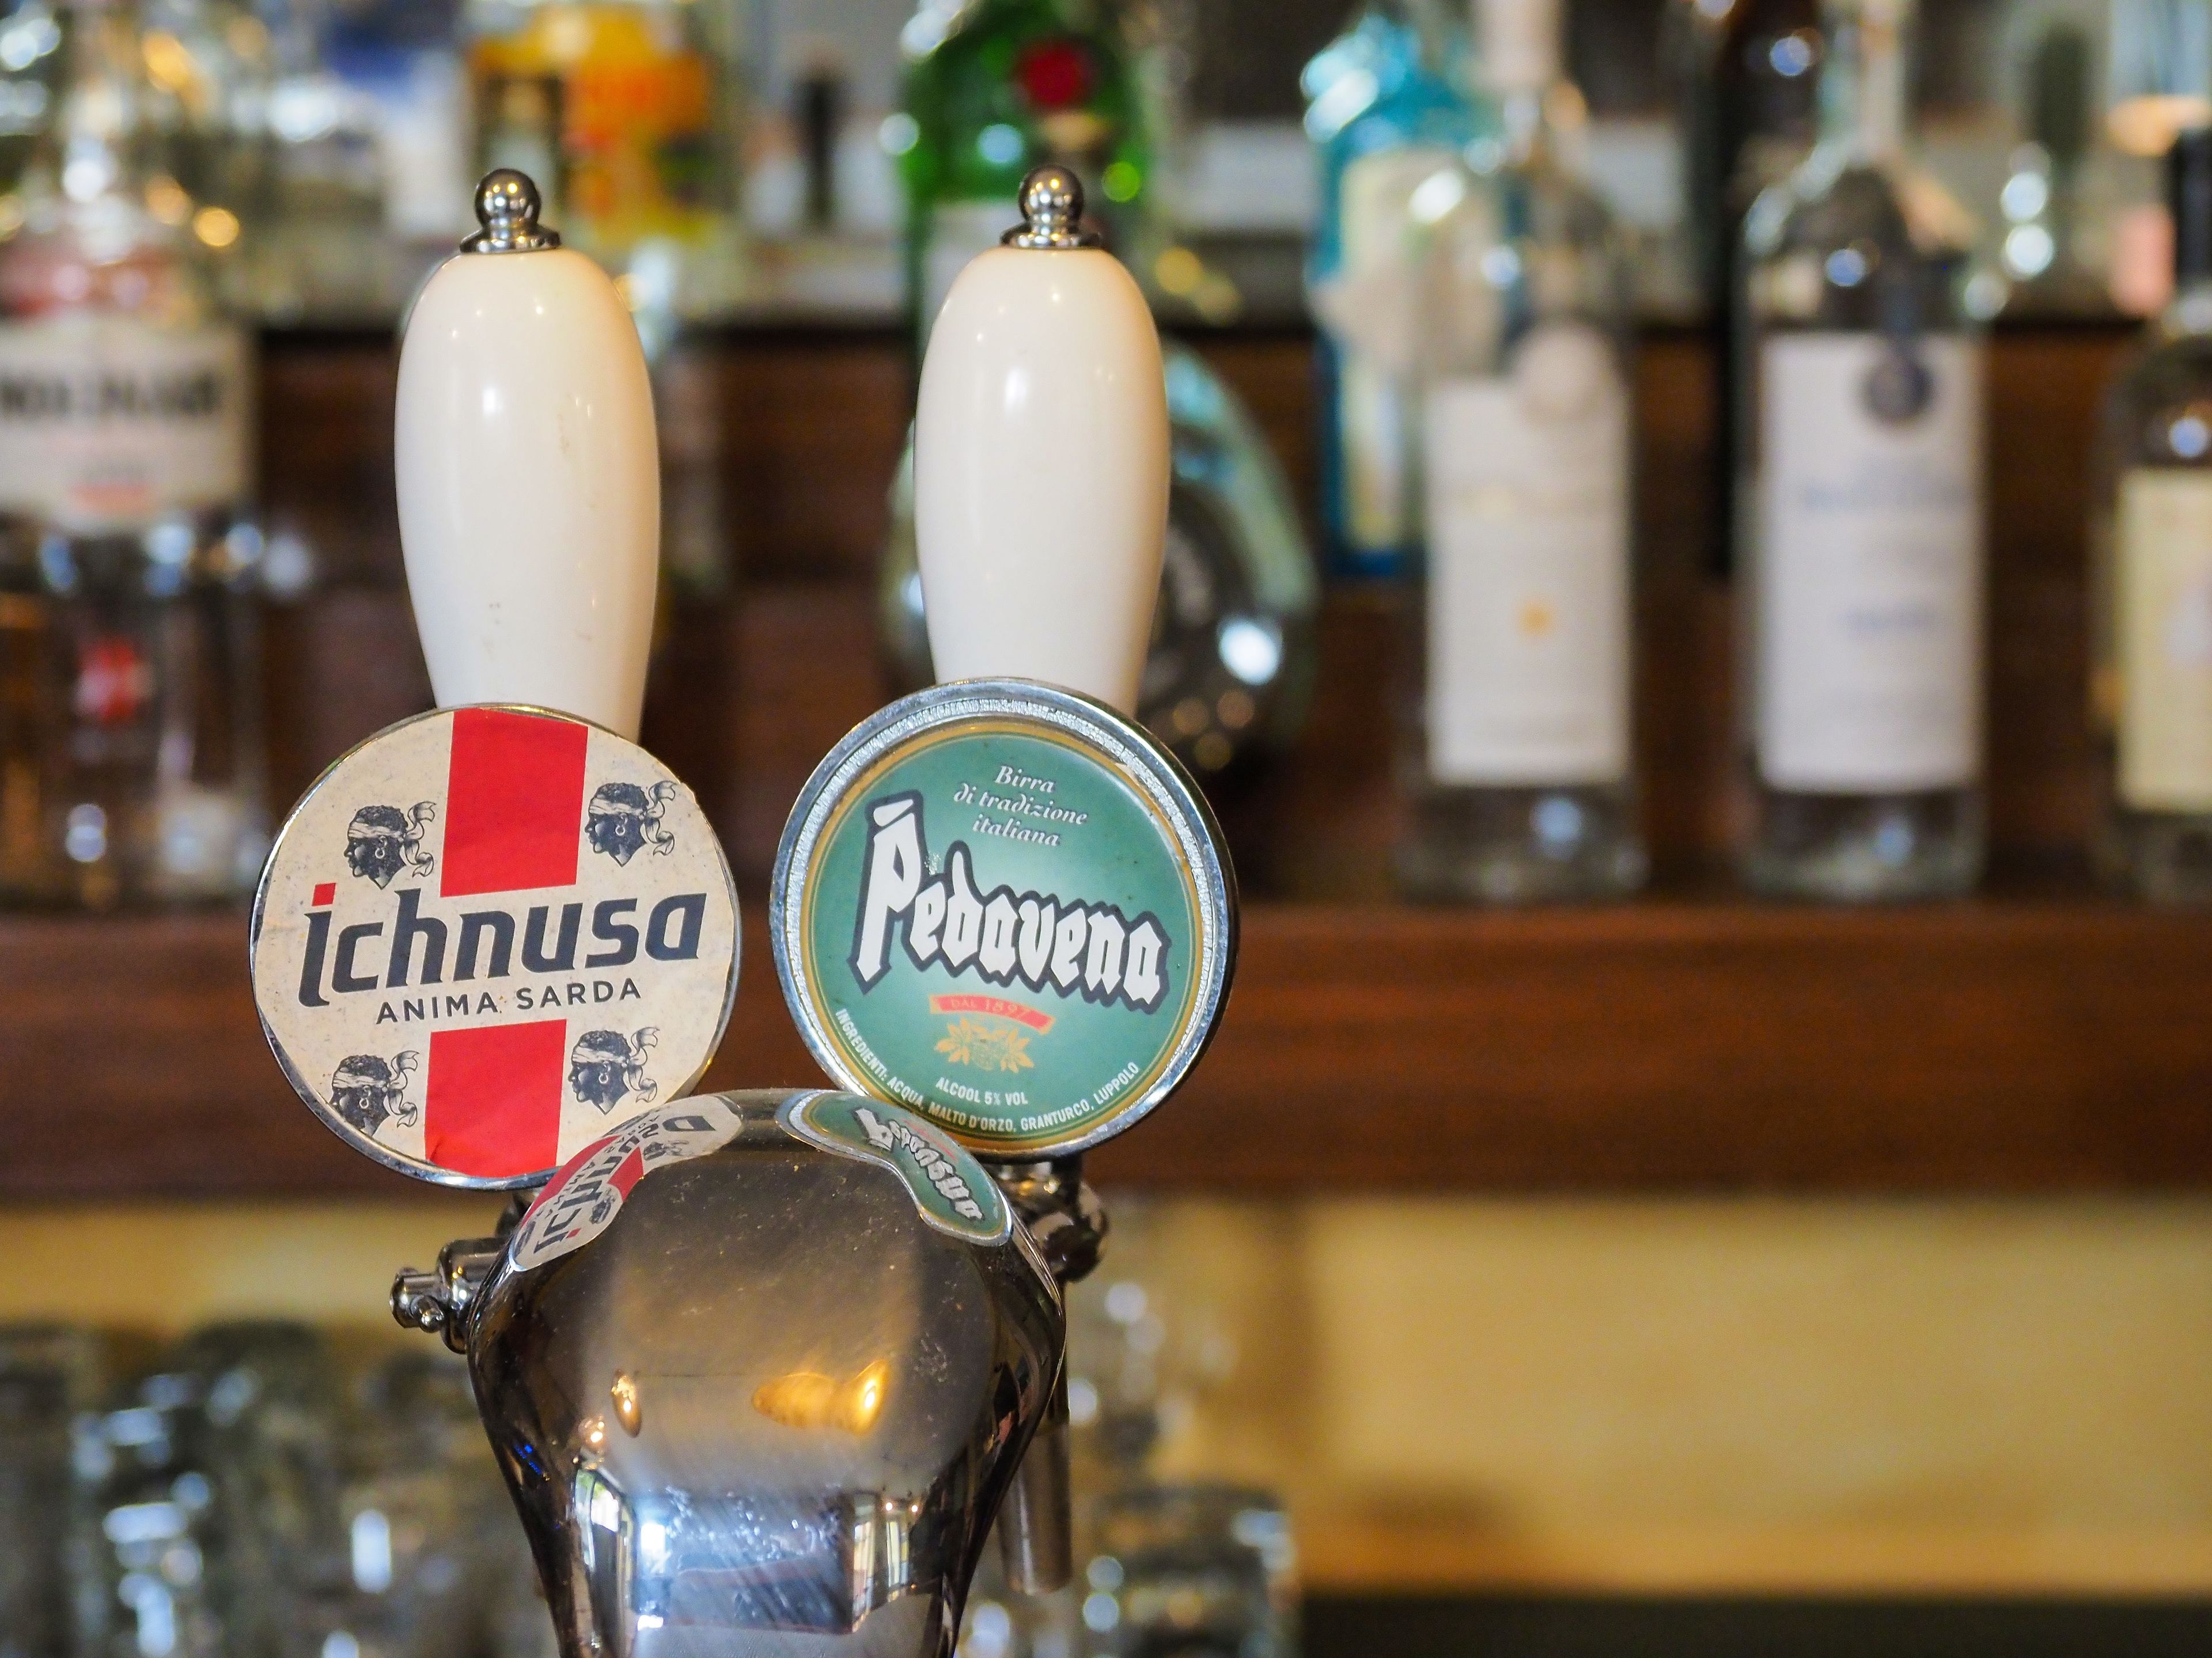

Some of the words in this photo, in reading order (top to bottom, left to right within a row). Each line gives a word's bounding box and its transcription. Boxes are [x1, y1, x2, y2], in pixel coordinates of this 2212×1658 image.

[995, 765, 1056, 793] Birra
[953, 783, 976, 804] di
[979, 792, 1088, 825] tradizione
[972, 814, 1060, 847] italiana
[849, 791, 1169, 1012] Pedavena
[298, 883, 707, 1008] ichnusa
[376, 992, 498, 1025] ANIMA
[516, 978, 641, 1010] SARDA
[835, 1008, 888, 1082] INGREDIENTI:
[927, 1101, 967, 1126] MALTO
[1021, 1098, 1094, 1132] GRANTURCO,
[1093, 1061, 1139, 1105] LUPPOLO
[935, 1077, 980, 1103] ALCOOL
[984, 1091, 1001, 1106] 5%
[1005, 1092, 1029, 1106] VOL
